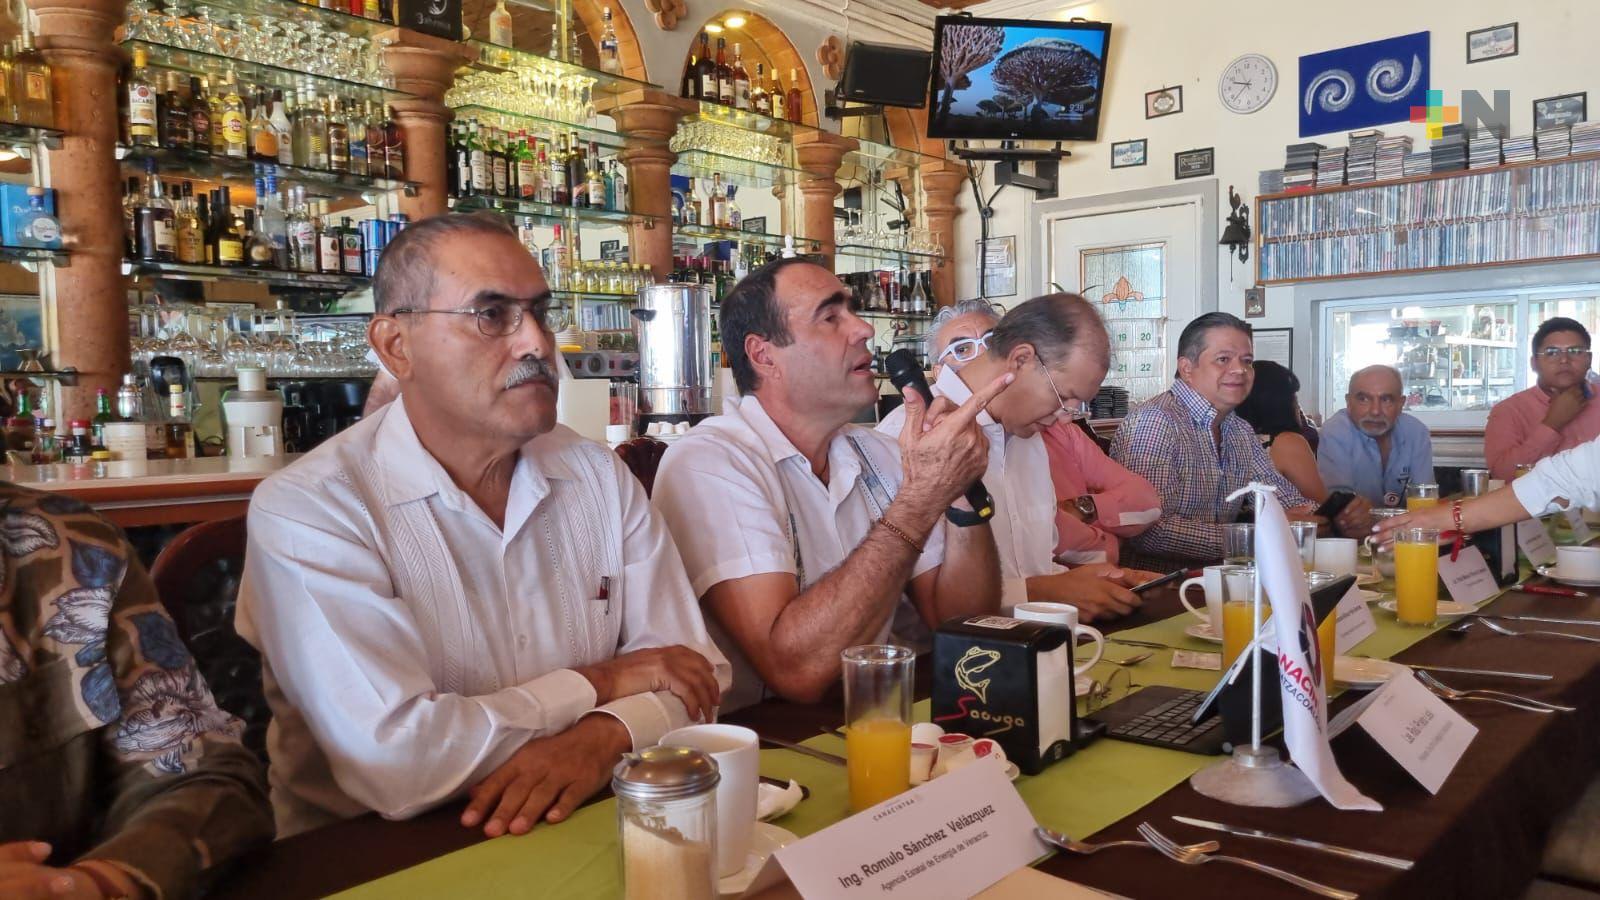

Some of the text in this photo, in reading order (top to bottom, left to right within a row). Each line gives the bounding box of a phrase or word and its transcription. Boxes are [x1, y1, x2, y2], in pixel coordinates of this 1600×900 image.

[1118, 333, 1127, 341] 19
[1140, 332, 1151, 341] 20
[1118, 364, 1127, 372] 21
[1140, 363, 1151, 371] 22
[838, 804, 996, 888] Ing. Romulo Sánchez Velázquez
[881, 830, 989, 891] Agencia Estatal de Energía de Veracruz
